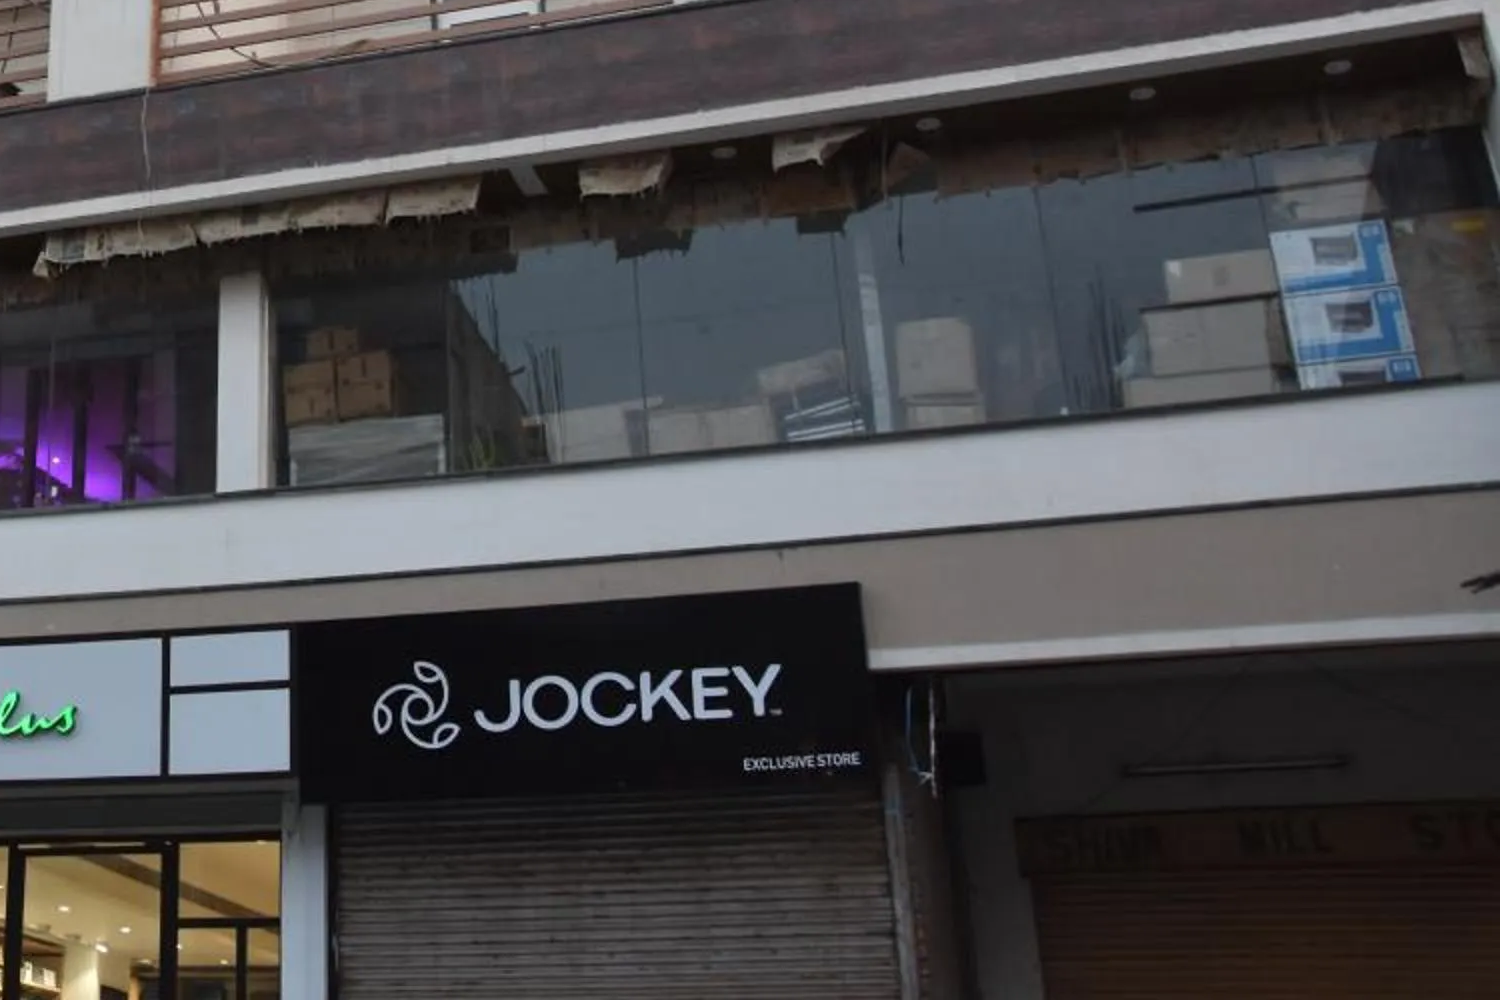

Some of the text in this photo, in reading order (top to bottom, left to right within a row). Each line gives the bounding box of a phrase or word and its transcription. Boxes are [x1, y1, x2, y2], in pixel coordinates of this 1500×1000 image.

[474, 664, 781, 732] JOCKEY
[743, 752, 861, 771] EXCLUSIVE STORE
